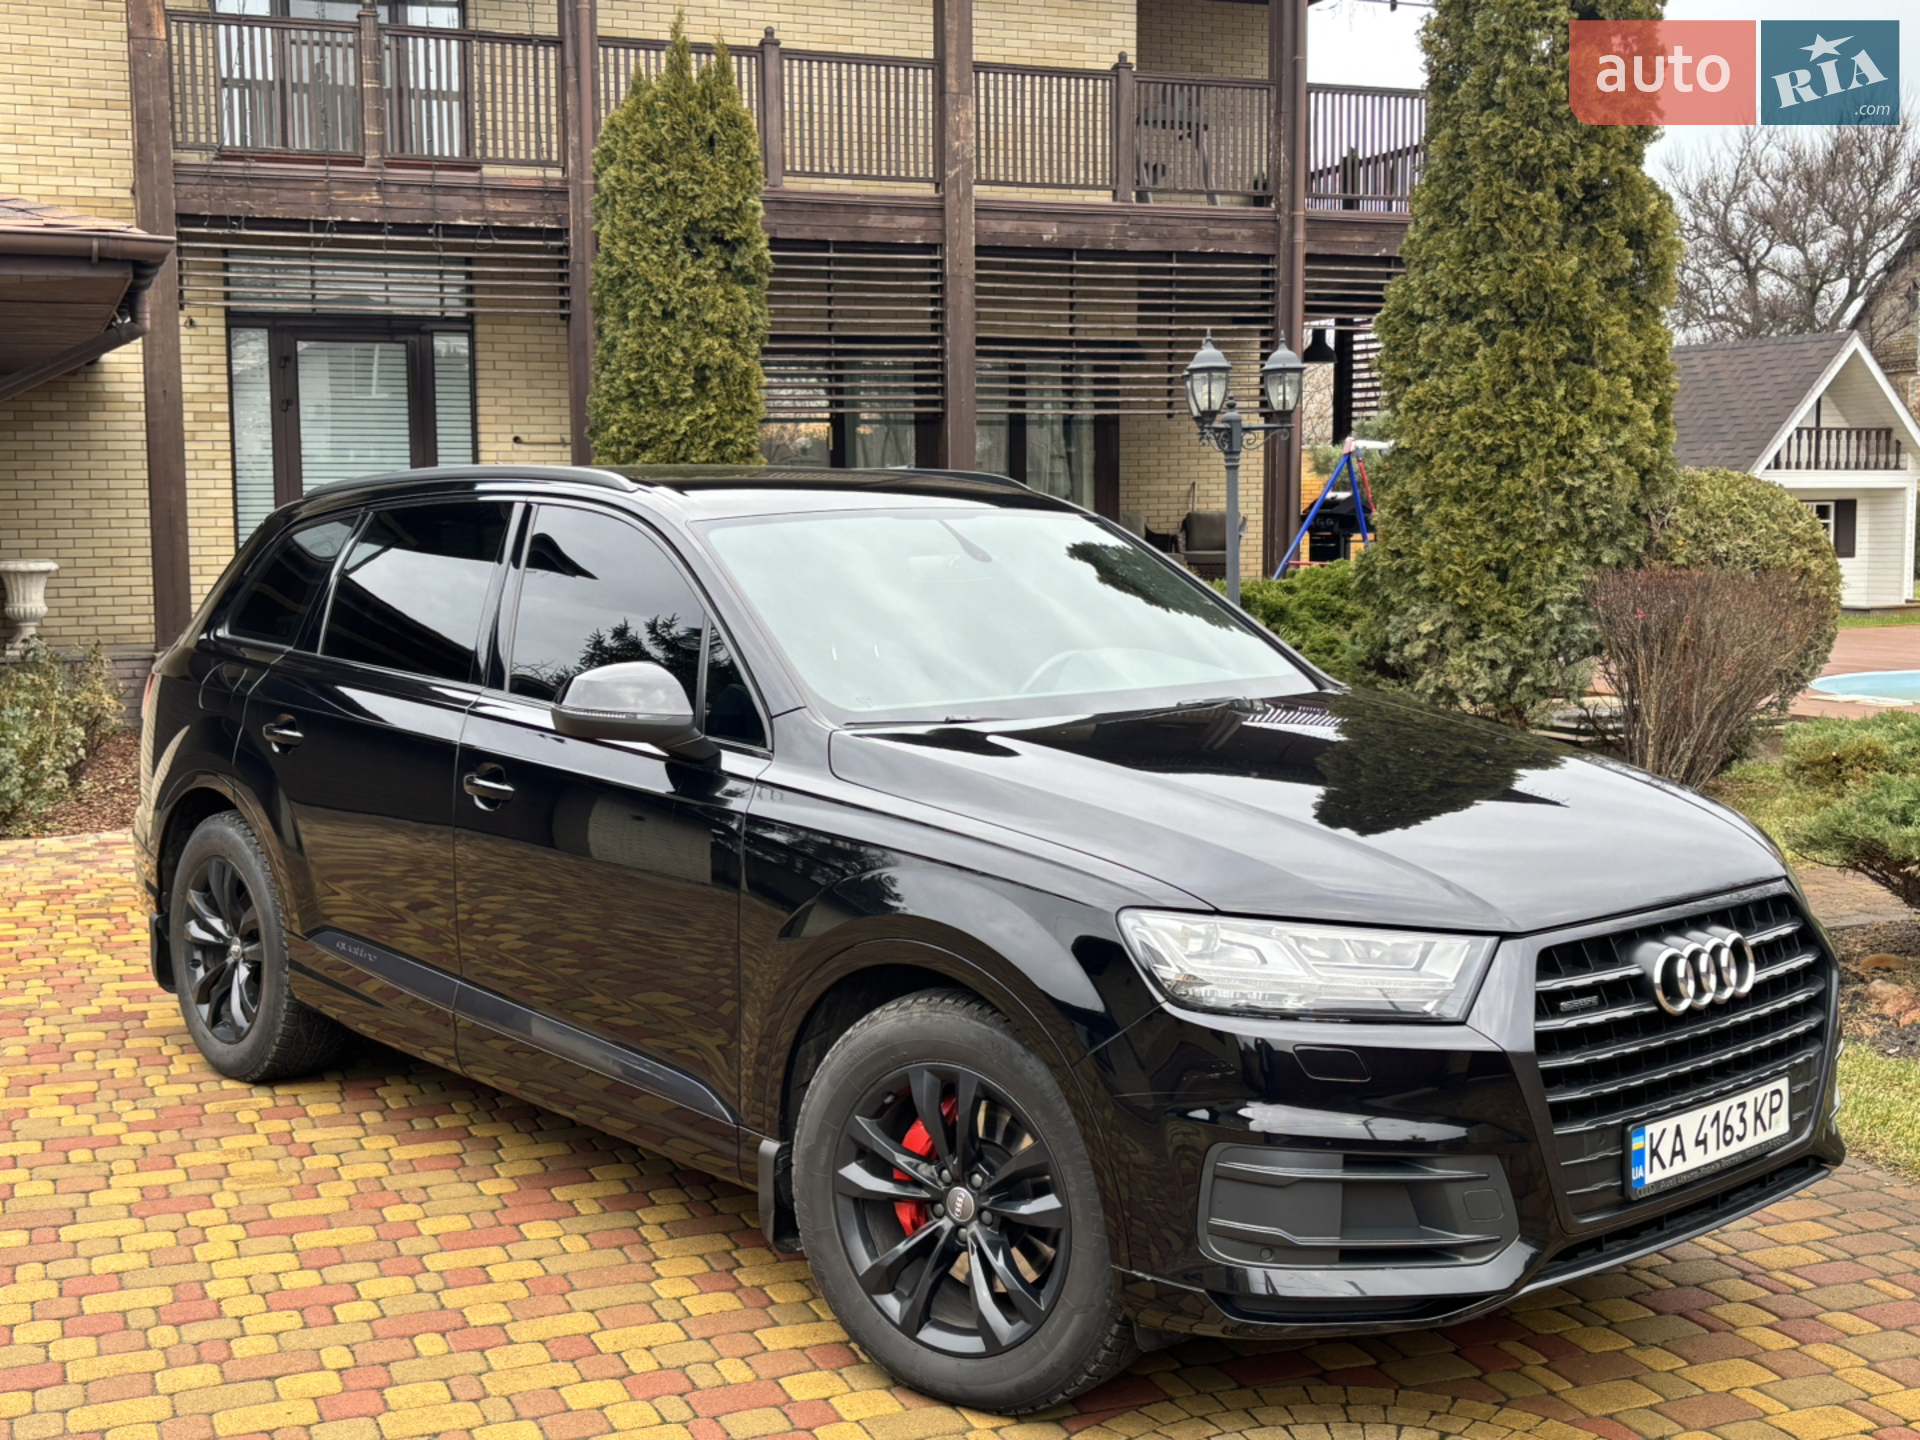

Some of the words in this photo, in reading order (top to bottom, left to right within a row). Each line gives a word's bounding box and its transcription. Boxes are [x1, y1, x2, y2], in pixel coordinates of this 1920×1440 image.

[1649, 1123, 1687, 1175] KA
[1694, 1100, 1748, 1156] 4163
[1753, 1087, 1784, 1137] KP
[1632, 1164, 1645, 1180] UA
